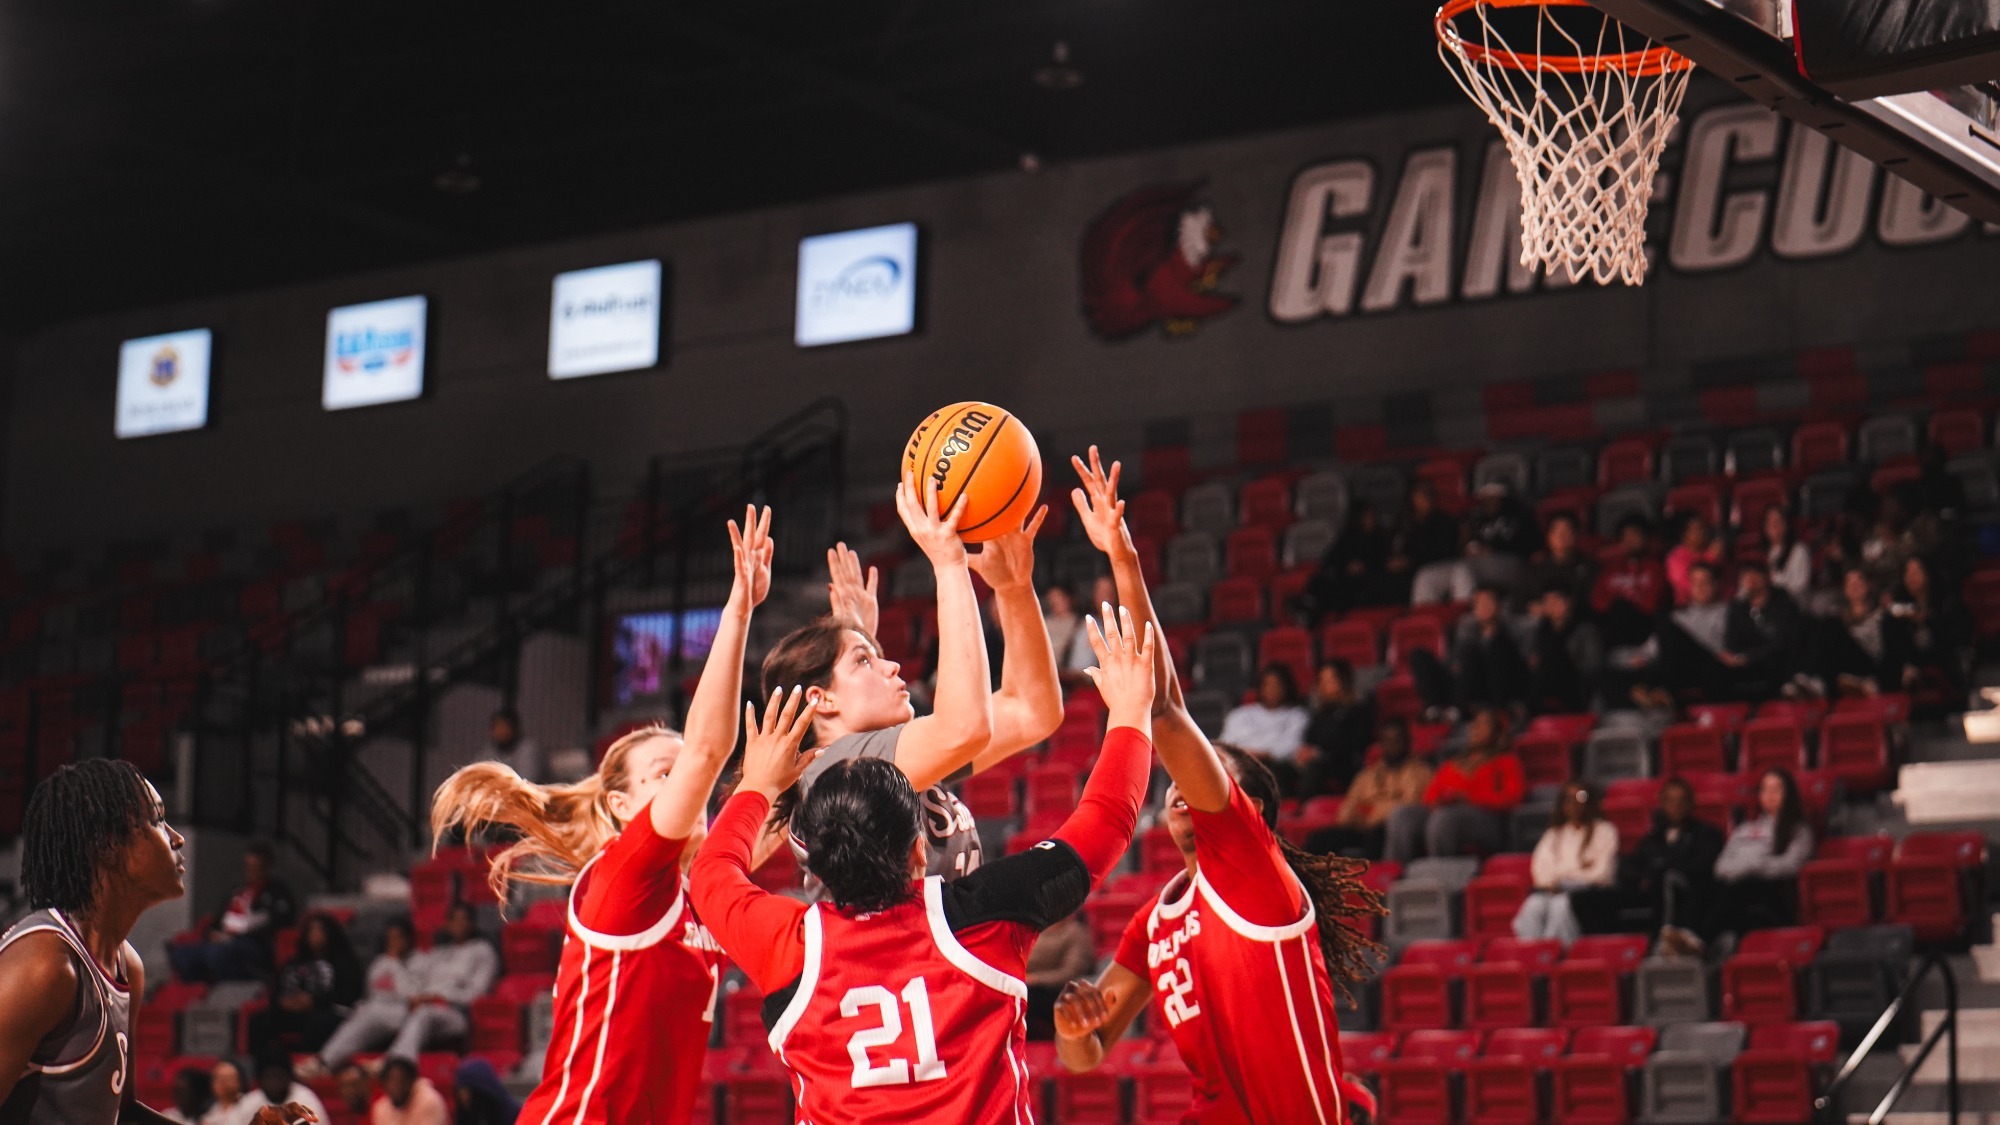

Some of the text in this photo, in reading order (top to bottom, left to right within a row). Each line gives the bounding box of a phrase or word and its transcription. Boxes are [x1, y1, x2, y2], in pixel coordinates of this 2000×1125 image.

[932, 411, 994, 491] Wilson
[839, 975, 948, 1089] 21
[1157, 957, 1201, 1029] 22
